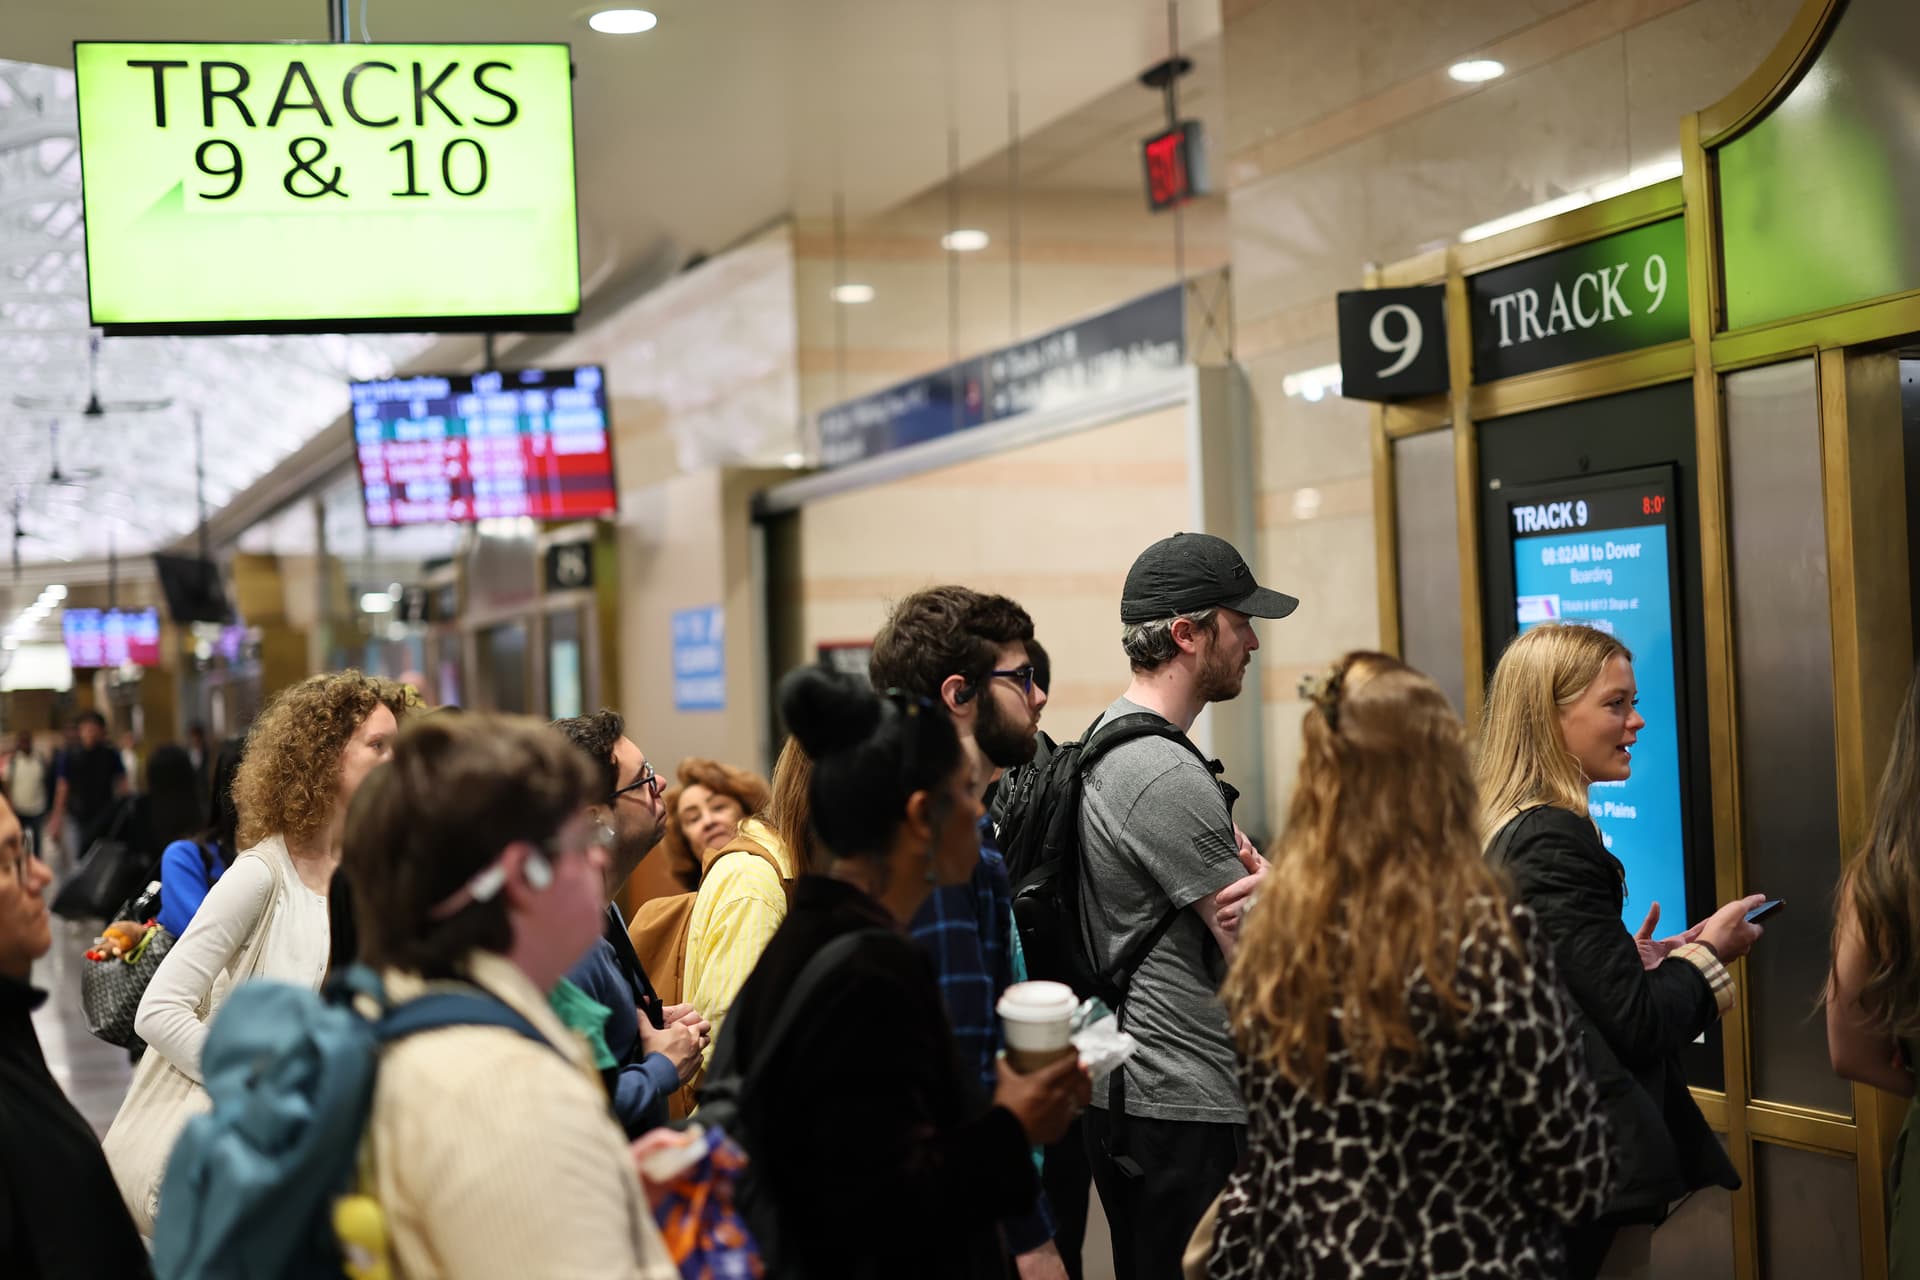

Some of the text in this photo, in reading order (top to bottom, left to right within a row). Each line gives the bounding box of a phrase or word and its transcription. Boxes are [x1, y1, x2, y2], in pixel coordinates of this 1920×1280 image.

[127, 59, 519, 128] TRACKS
[194, 136, 489, 200] 9 & 10
[1489, 254, 1668, 348] TRACK 9
[1369, 304, 1423, 378] 9
[1512, 500, 1588, 533] TRACK 9
[1591, 544, 1604, 561] to
[1605, 541, 1642, 560] Dover
[1570, 566, 1613, 586] Boarding
[1604, 801, 1637, 819] Plains
